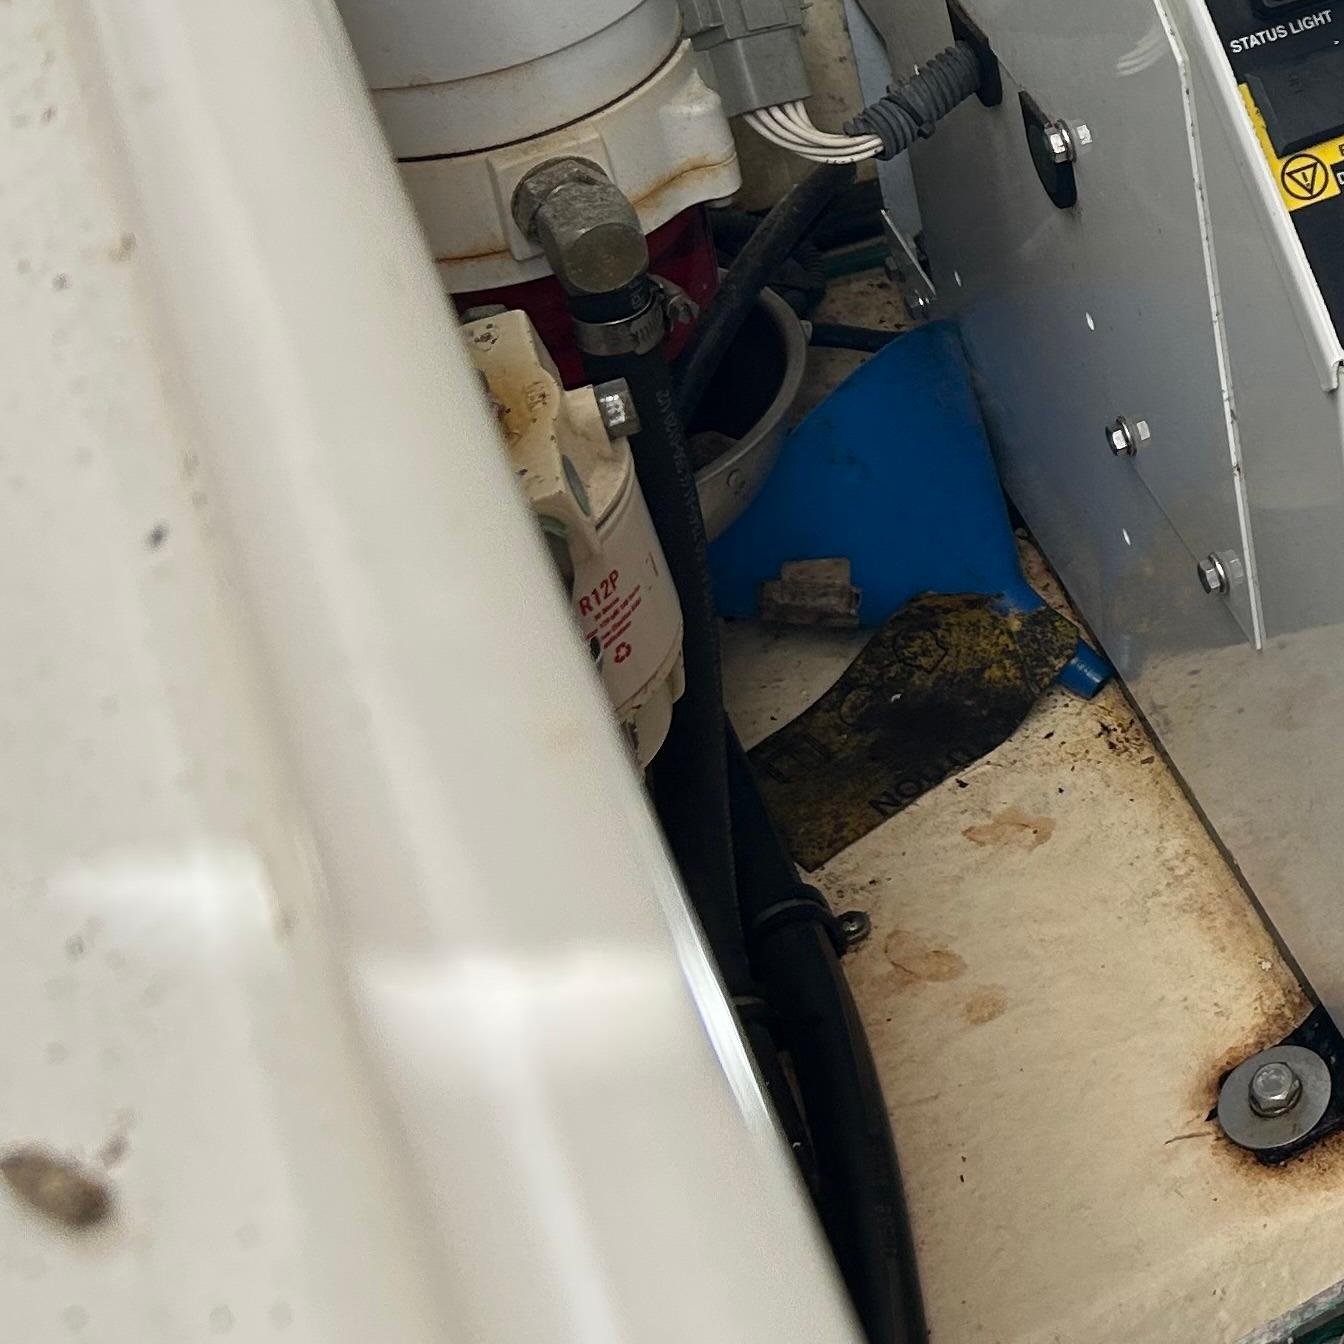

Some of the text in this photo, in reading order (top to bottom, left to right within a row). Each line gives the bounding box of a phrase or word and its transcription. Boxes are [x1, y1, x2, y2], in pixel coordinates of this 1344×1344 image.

[1230, 10, 1330, 52] STATUS LIGHT
[579, 569, 619, 616] R12P
